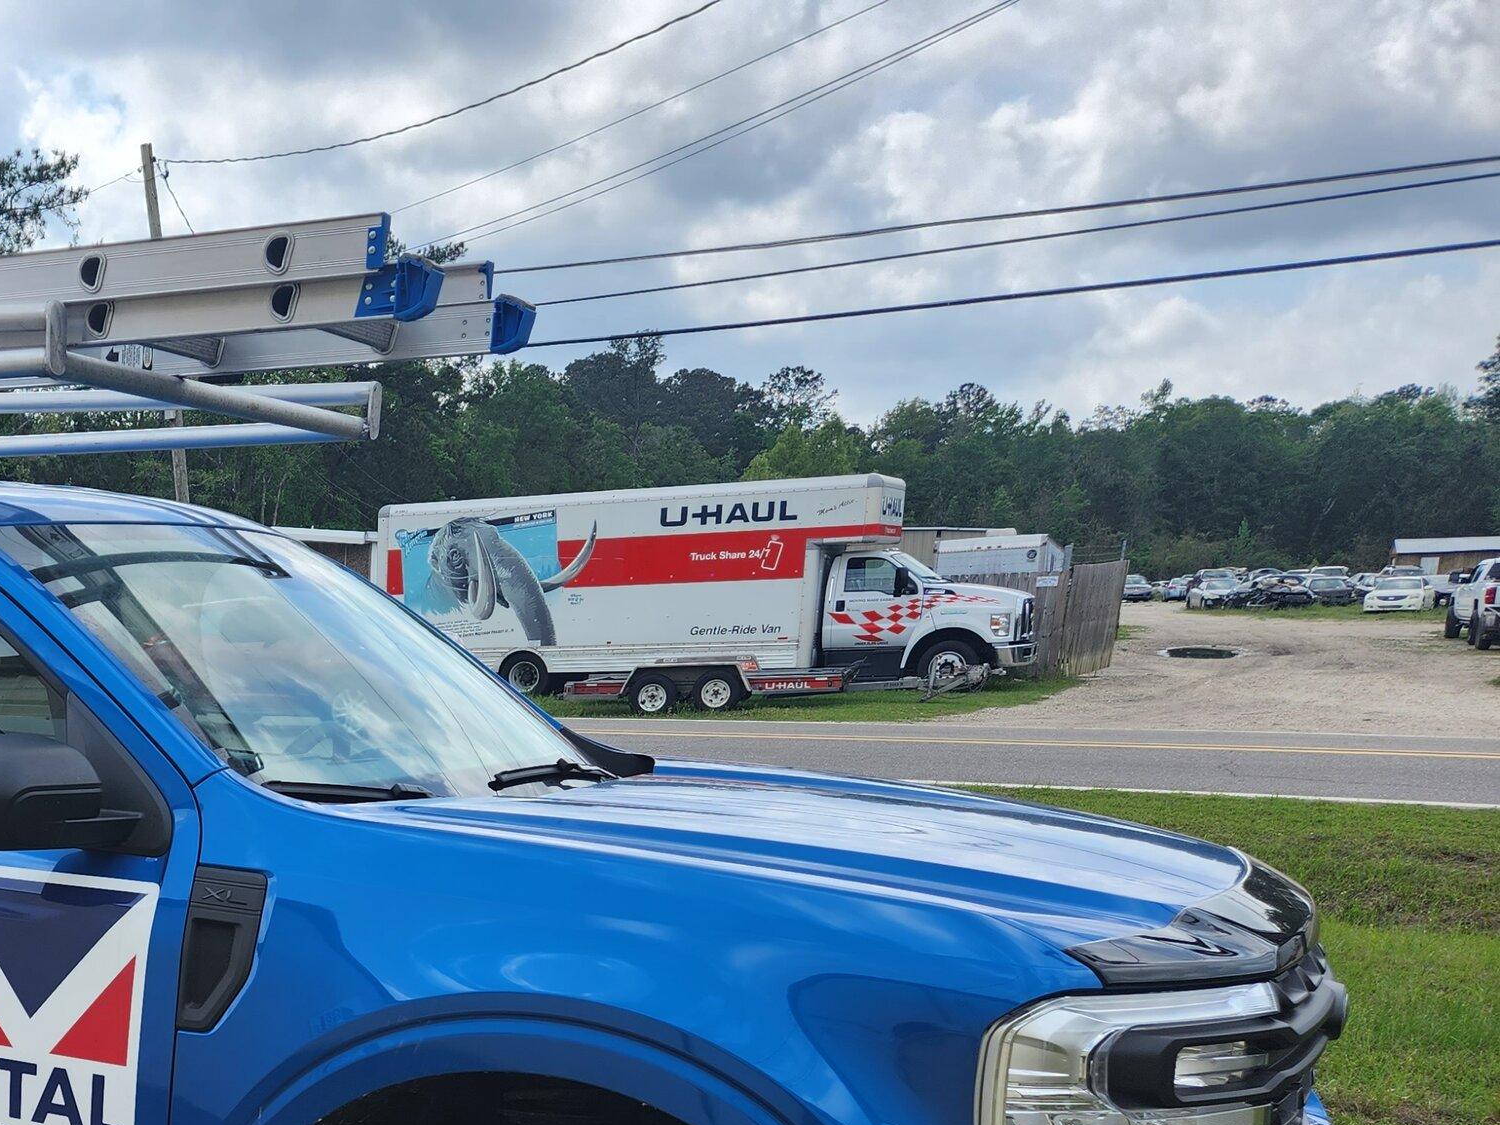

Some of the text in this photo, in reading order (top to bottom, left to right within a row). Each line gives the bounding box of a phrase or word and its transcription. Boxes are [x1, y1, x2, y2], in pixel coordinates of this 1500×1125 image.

[514, 511, 553, 523] NEW YORK
[660, 500, 798, 527] U-HAUL
[690, 548, 771, 561] Truck Share 24/7
[690, 624, 781, 636] Gentle-Ride Van
[765, 681, 811, 690] U-HAUL
[202, 887, 247, 905] XL
